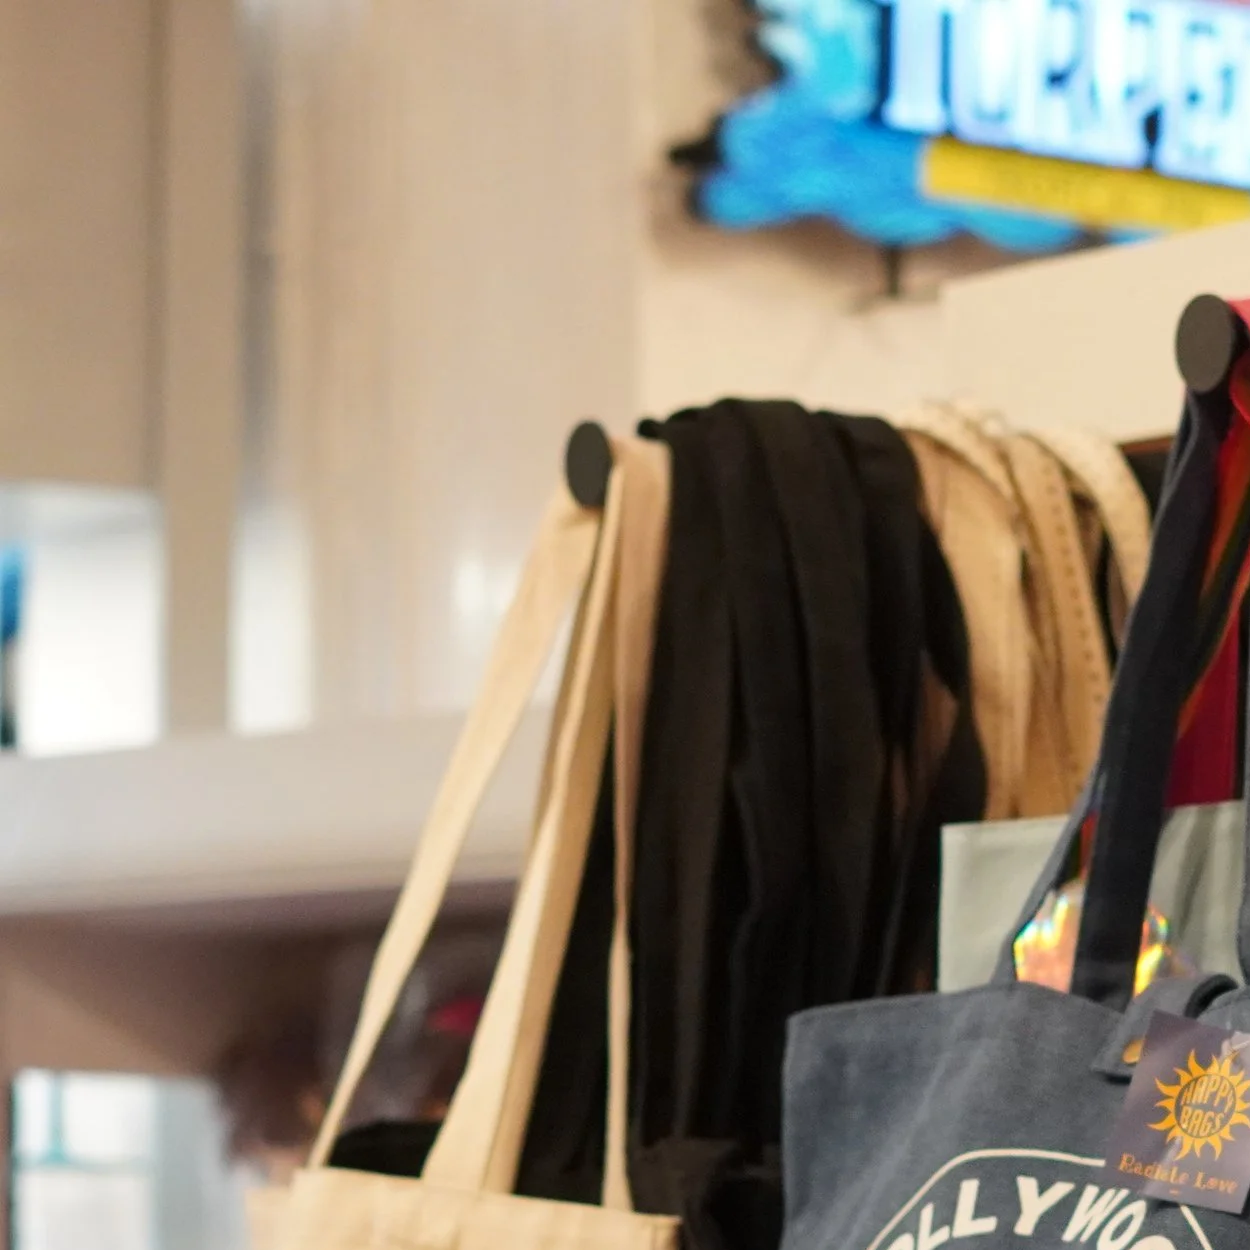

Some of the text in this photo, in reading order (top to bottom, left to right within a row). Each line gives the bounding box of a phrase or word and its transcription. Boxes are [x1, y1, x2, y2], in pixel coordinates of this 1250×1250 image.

[1181, 1077, 1234, 1113] HAPPY
[1181, 1106, 1225, 1136] BAGS
[1195, 1171, 1238, 1194] Love
